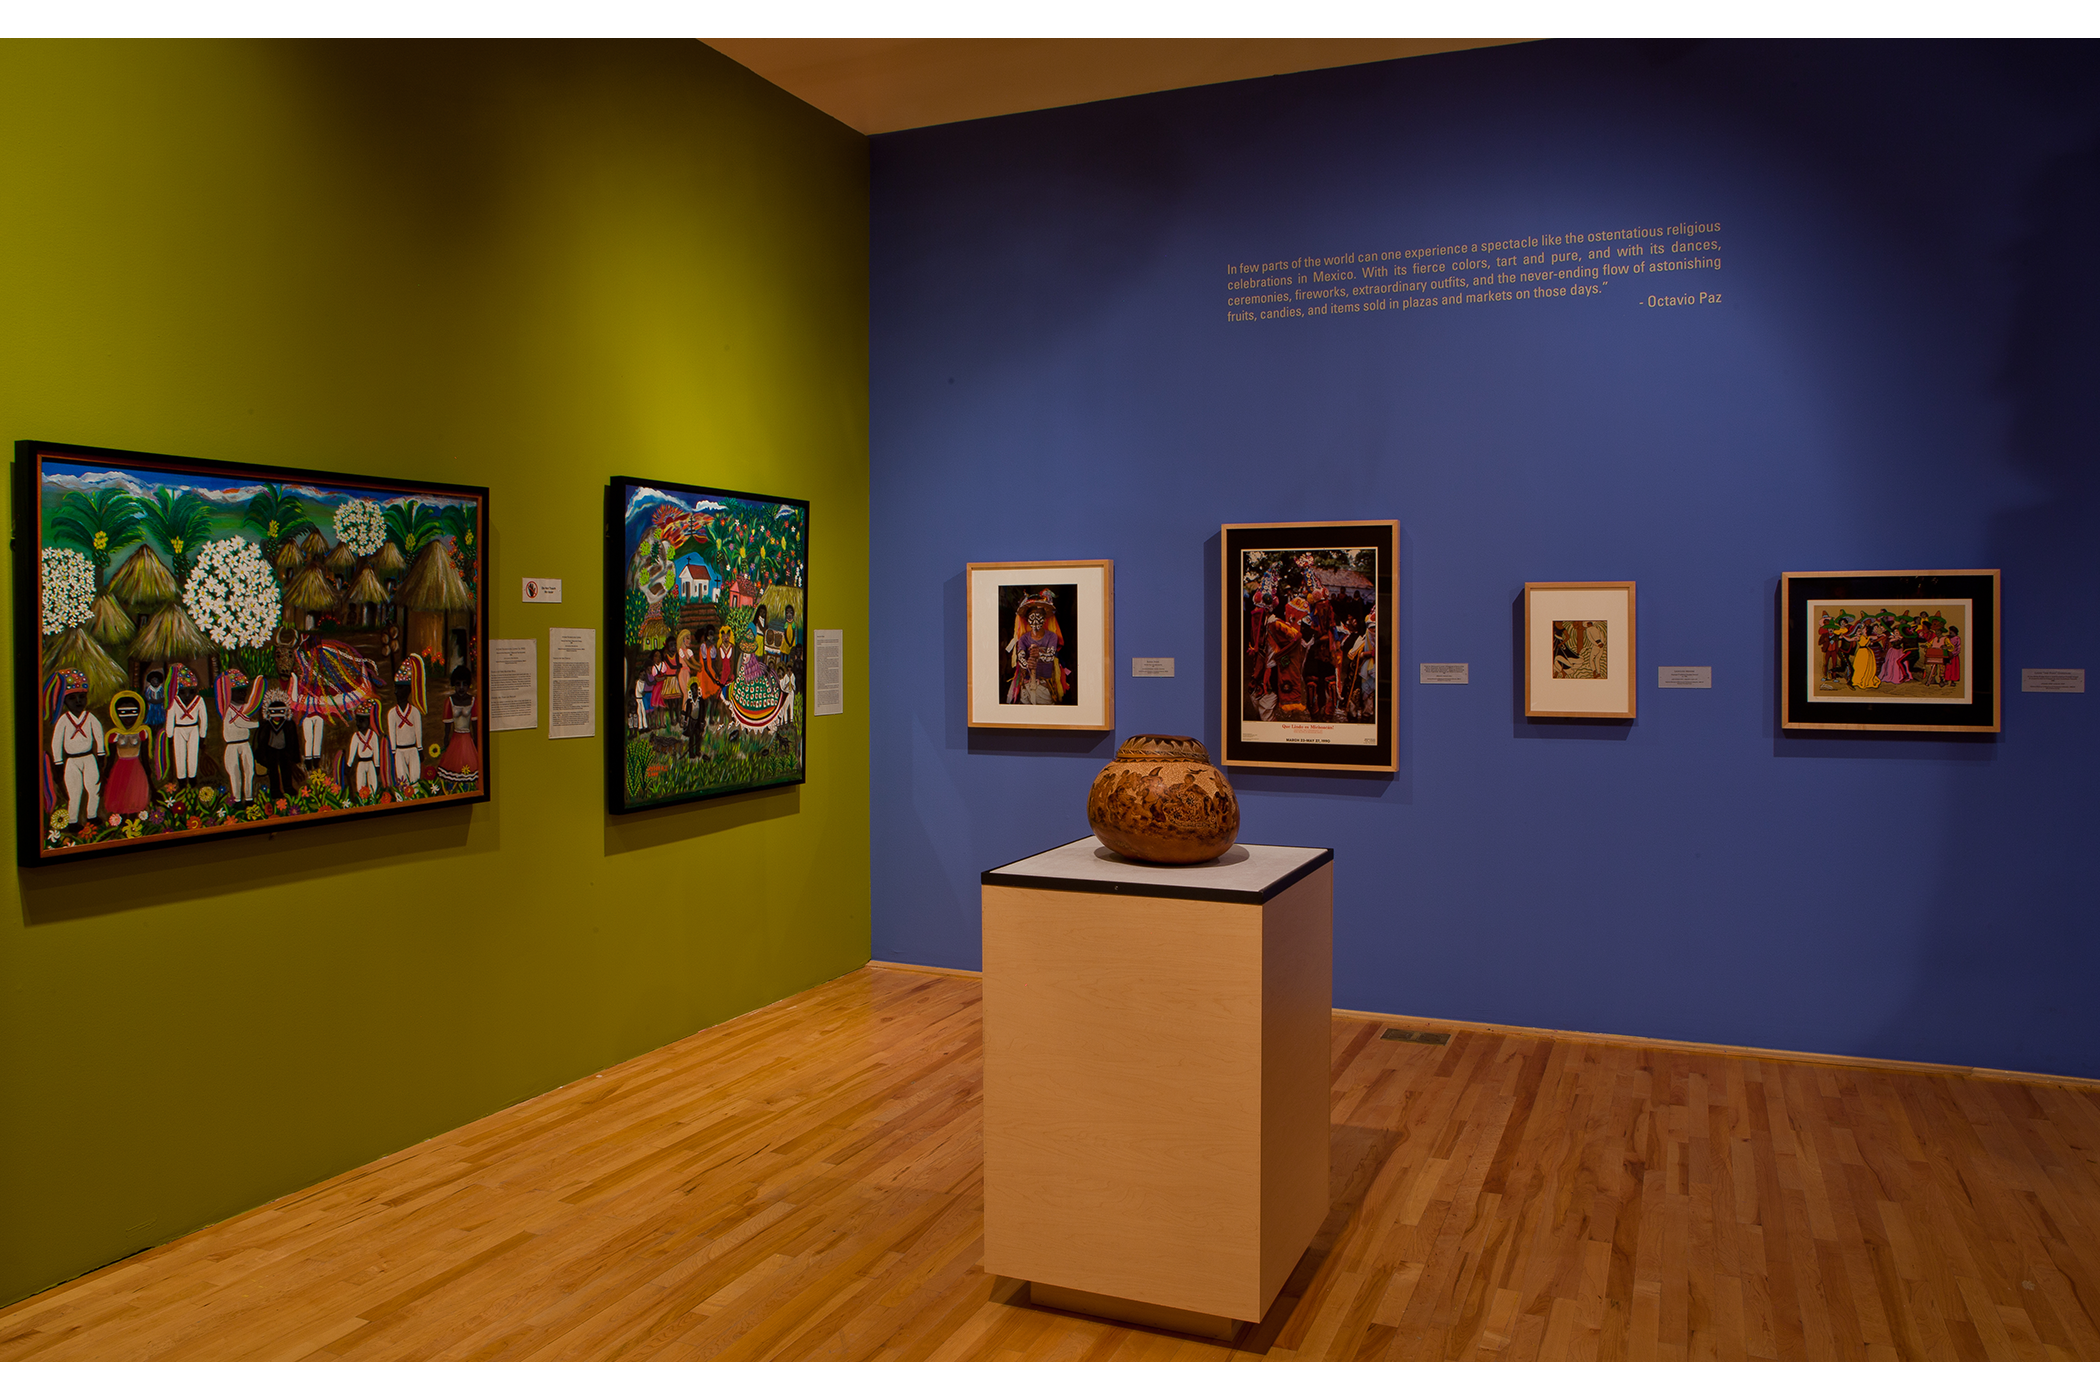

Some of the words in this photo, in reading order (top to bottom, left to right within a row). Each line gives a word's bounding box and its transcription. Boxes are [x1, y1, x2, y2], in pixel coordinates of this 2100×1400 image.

[1227, 264, 1237, 275] In
[1239, 262, 1260, 273] few
[1262, 260, 1289, 274] parts
[1291, 257, 1302, 269] of
[1304, 256, 1321, 268] the
[1323, 252, 1355, 266] world
[1358, 253, 1378, 263] can
[1381, 250, 1402, 261] one
[1404, 244, 1468, 260] experience
[1471, 243, 1478, 252] a
[1481, 236, 1538, 253] spectacle
[1541, 234, 1562, 246] like
[1565, 232, 1584, 244] the
[1587, 226, 1664, 242] ostentatious
[1667, 221, 1721, 236] religious
[1227, 276, 1293, 290] celebrations
[1298, 273, 1307, 284] in
[1313, 270, 1356, 282] Mexico.
[1362, 266, 1388, 278] With
[1394, 264, 1407, 275] its
[1413, 263, 1445, 274] fierce
[1452, 258, 1490, 271] colors,
[1496, 256, 1517, 267] tart
[1523, 251, 1545, 265] and
[1551, 252, 1582, 265] pure,
[1588, 246, 1611, 259] and
[1617, 244, 1643, 257] with
[1650, 242, 1665, 254] its
[1671, 240, 1722, 253] dances,
[1227, 291, 1292, 306] ceremonies,
[1295, 286, 1349, 300] fireworks,
[1352, 281, 1427, 296] extraordinary
[1430, 276, 1469, 289] outfits,
[1473, 273, 1494, 286] and
[1497, 272, 1516, 284] the
[1520, 266, 1599, 282] never-ending
[1603, 264, 1630, 275] flow
[1633, 261, 1645, 274] of
[1649, 256, 1721, 272] astonishing
[1227, 310, 1257, 322] fruits,
[1260, 306, 1305, 319] candies,
[1307, 303, 1327, 316] and
[1331, 303, 1360, 314] items
[1363, 299, 1386, 312] sold
[1389, 298, 1399, 309] in
[1402, 296, 1438, 311] plazas
[1441, 292, 1463, 305] and
[1466, 290, 1513, 303] markets
[1516, 290, 1530, 300] on
[1533, 286, 1567, 298] those
[1647, 293, 1695, 308] Octavio
[1699, 291, 1722, 304] Paz
